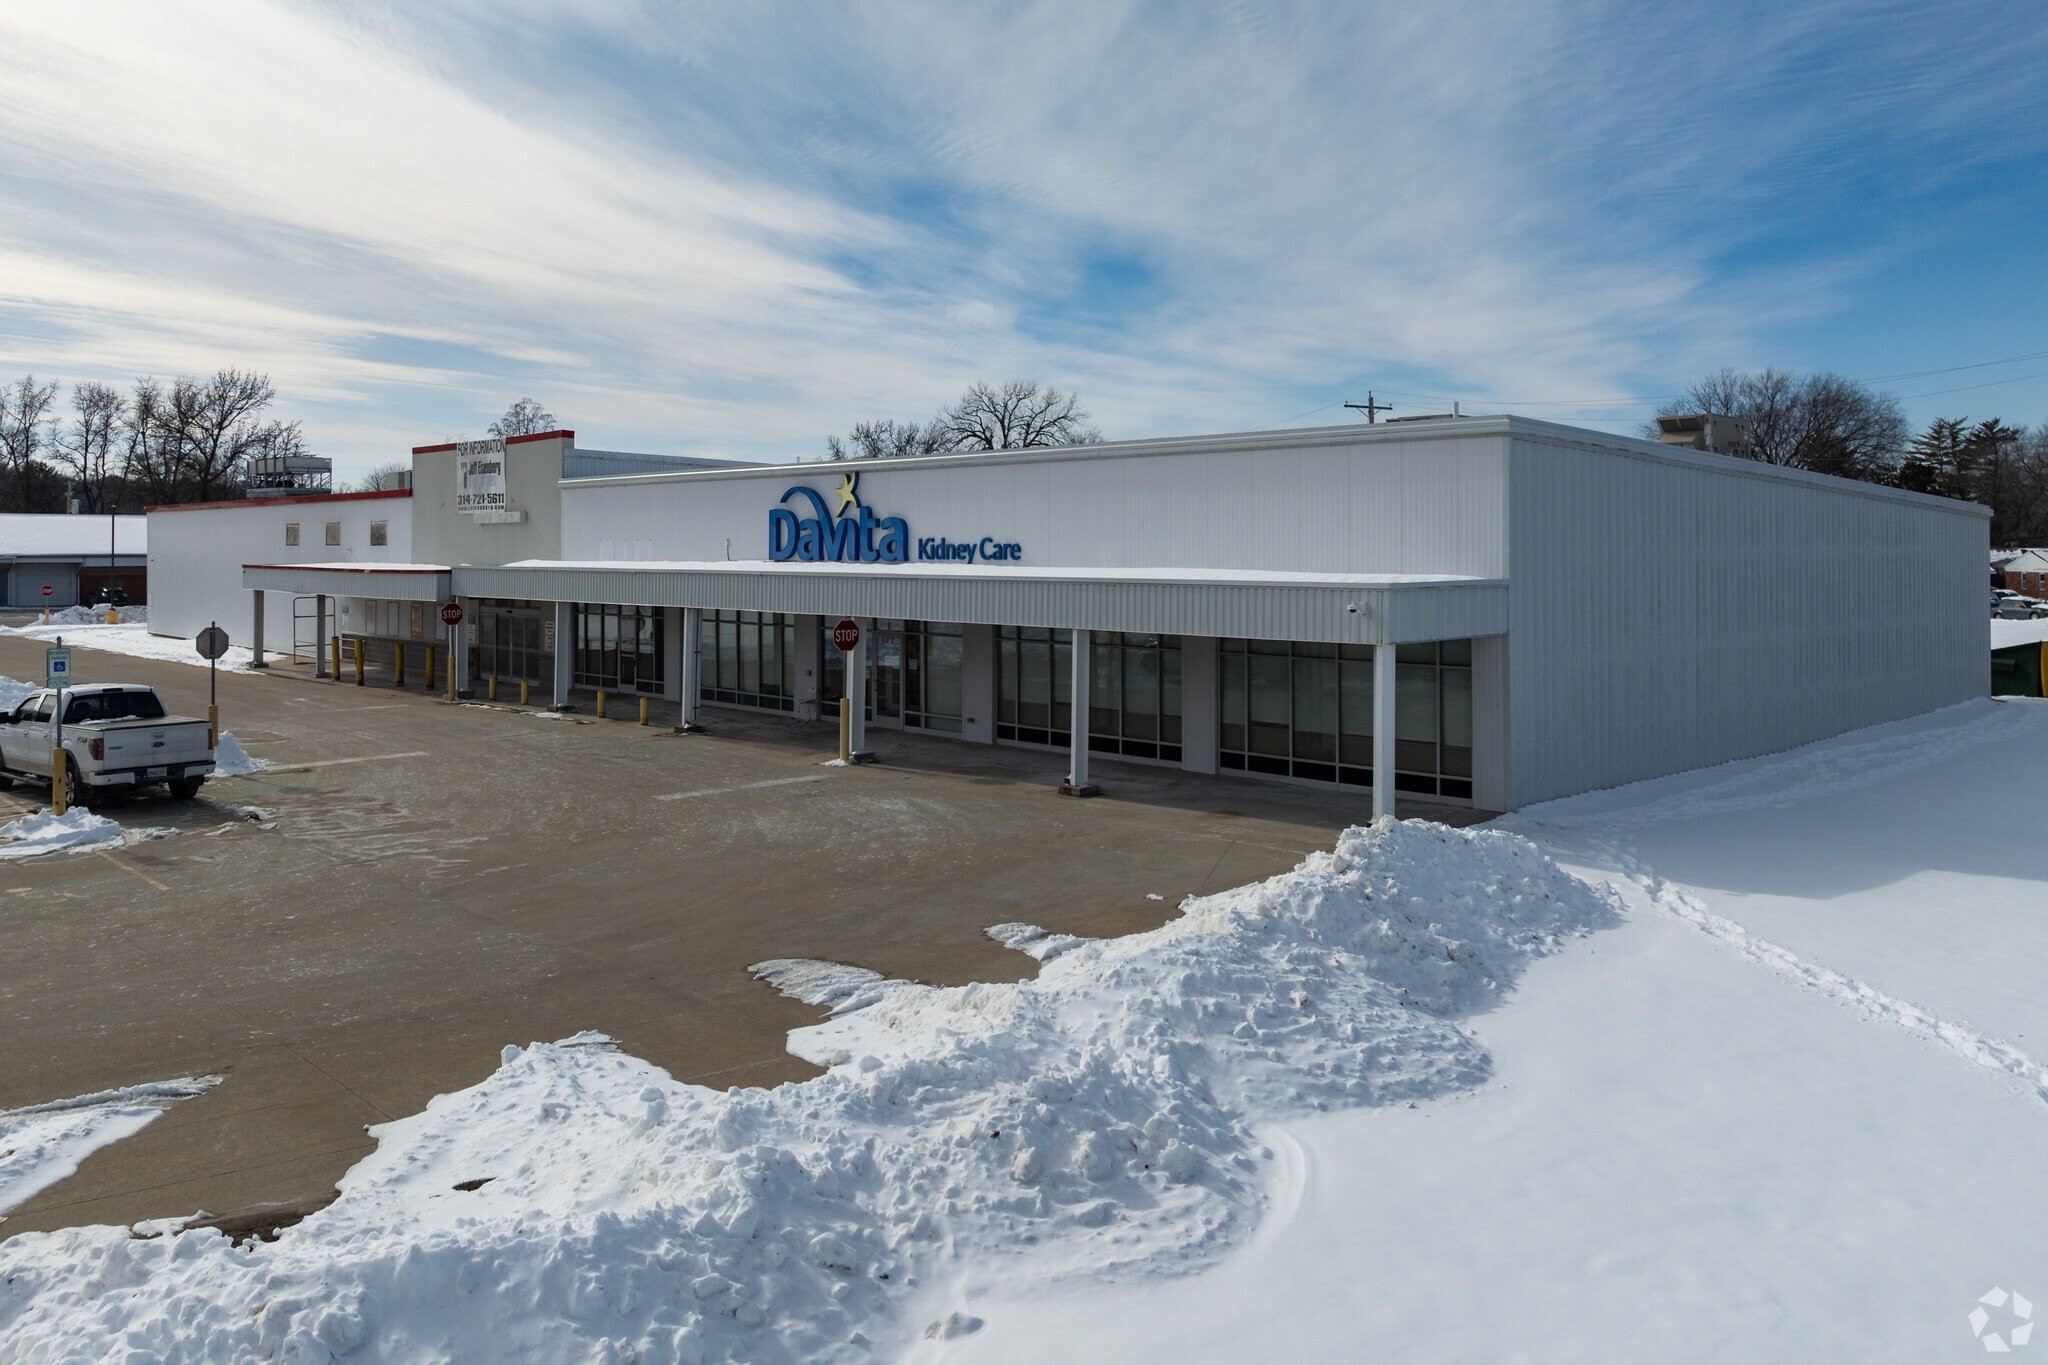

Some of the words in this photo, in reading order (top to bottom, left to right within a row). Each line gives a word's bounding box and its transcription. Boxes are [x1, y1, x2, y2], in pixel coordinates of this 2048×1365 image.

[458, 442, 468, 456] FOR
[469, 439, 505, 455] INFORMATION
[468, 461, 478, 475] Jeff
[457, 493, 504, 505] 314-721-5611
[769, 486, 909, 562] DaVita
[917, 537, 978, 564] Kidney
[979, 537, 1022, 561] Care
[442, 610, 462, 619] STOP
[835, 629, 858, 641] STOP
